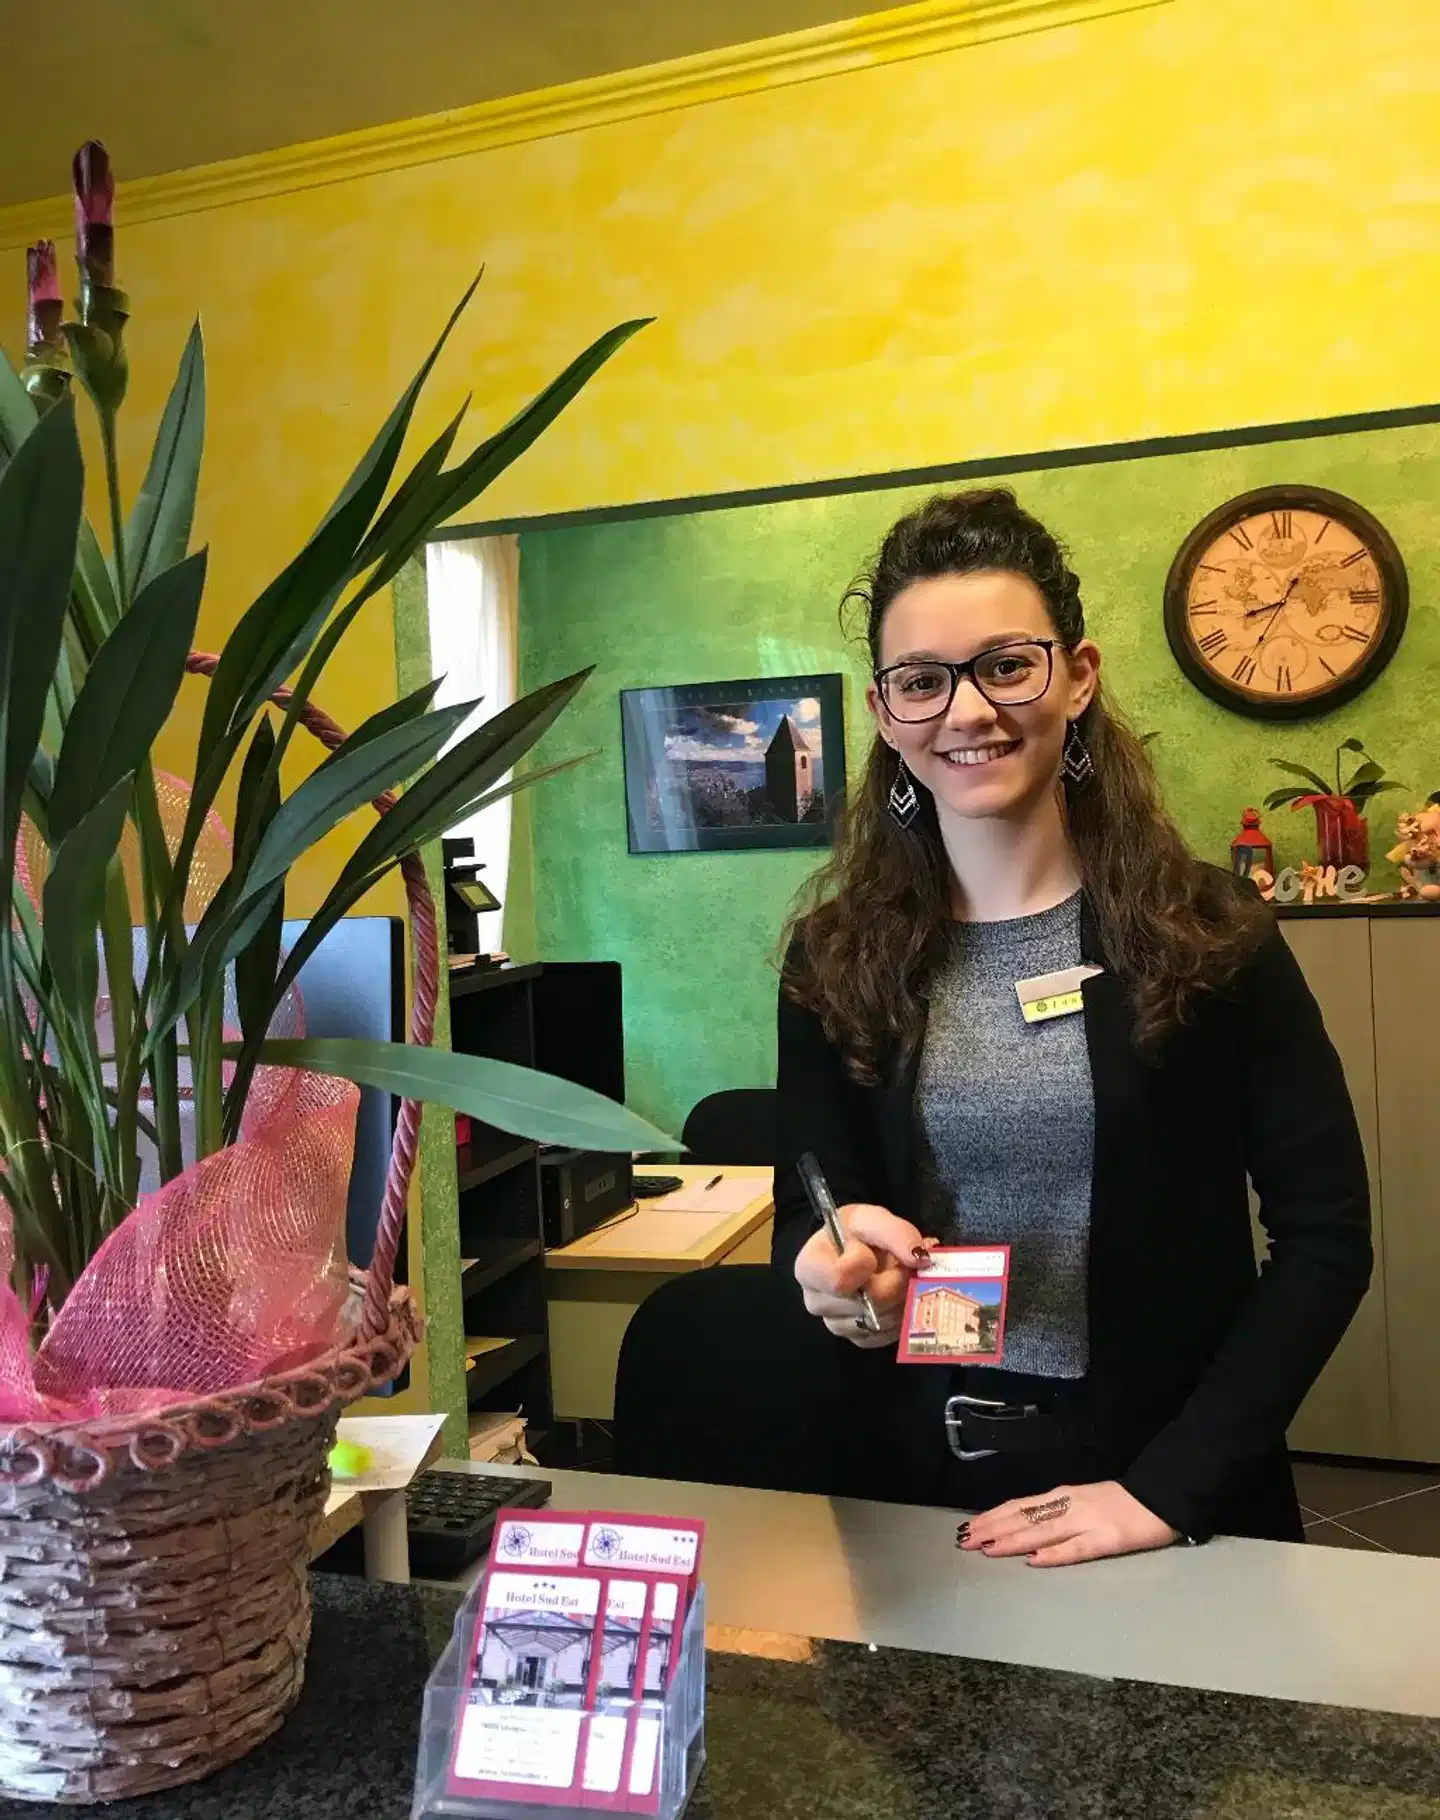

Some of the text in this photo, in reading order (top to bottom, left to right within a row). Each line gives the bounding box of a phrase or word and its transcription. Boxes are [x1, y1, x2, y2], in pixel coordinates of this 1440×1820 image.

[529, 1547, 558, 1558] Hotel
[618, 1550, 692, 1567] Hotel Sud Est
[506, 1592, 579, 1607] Hotel Sud Est
